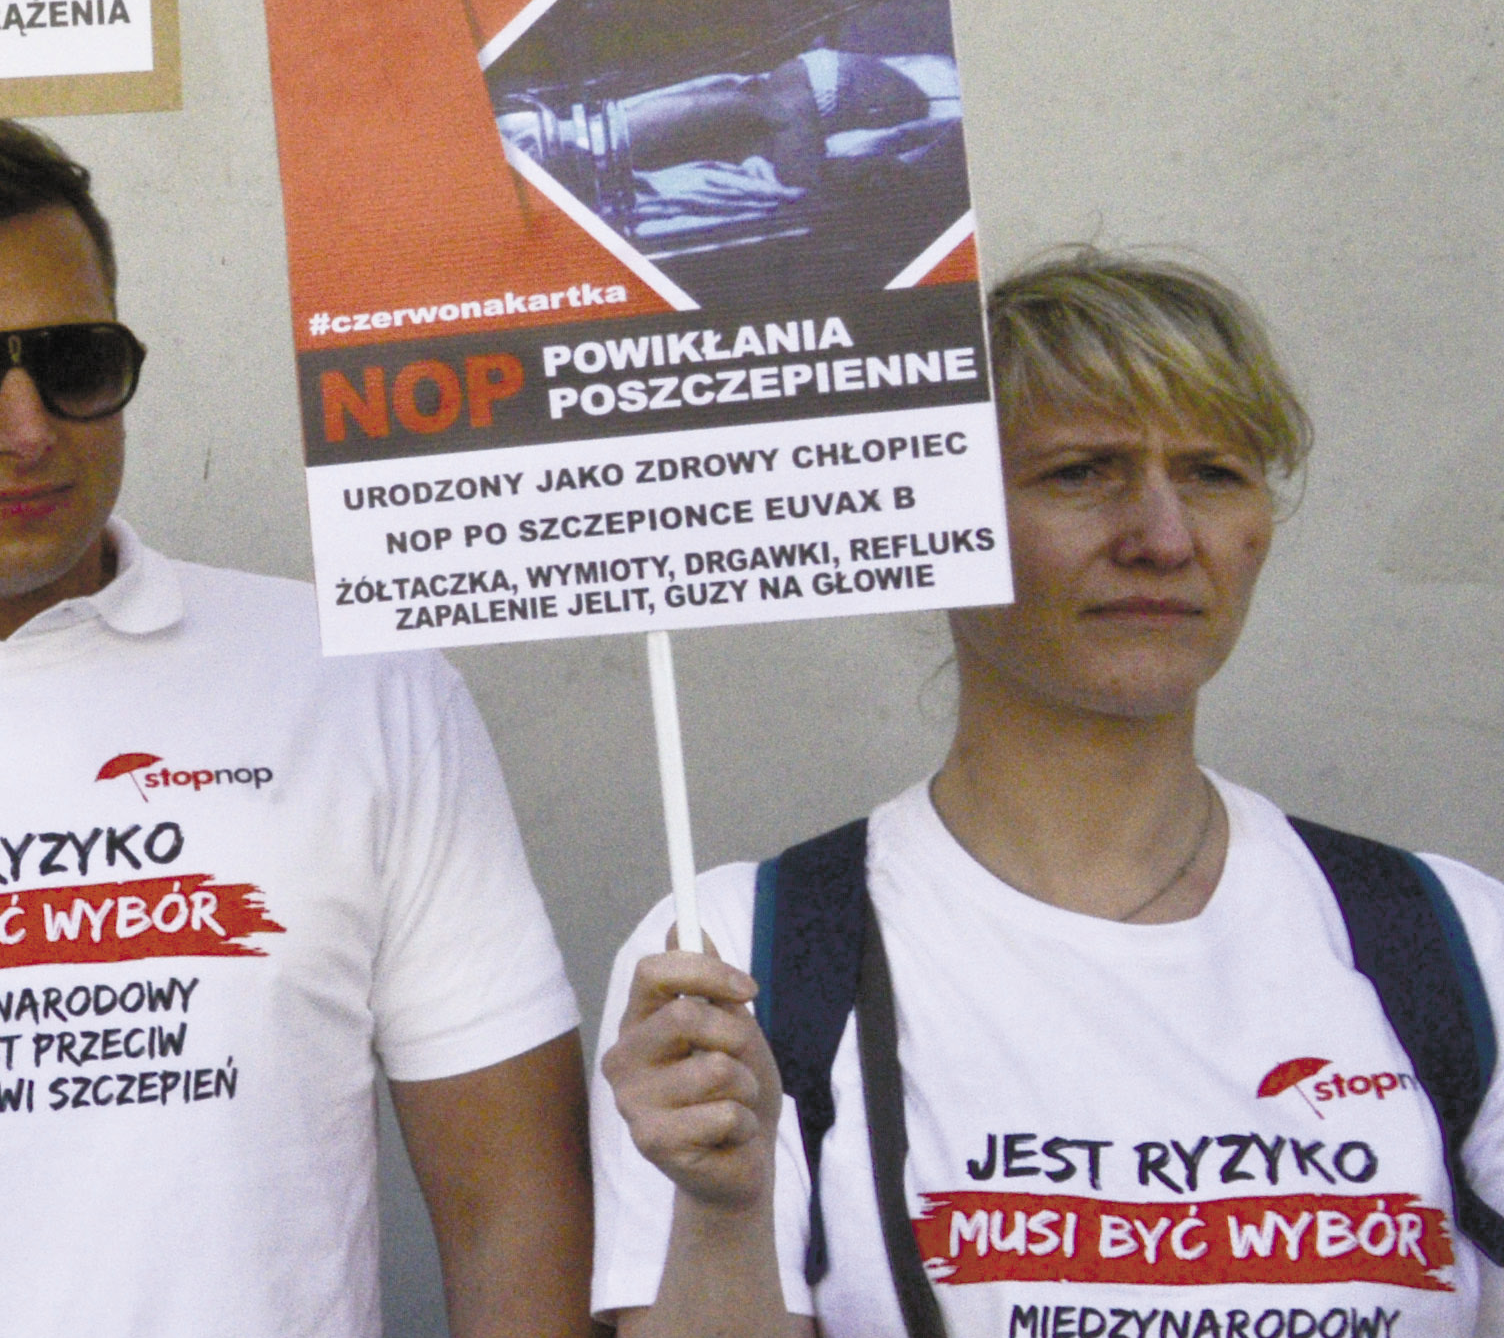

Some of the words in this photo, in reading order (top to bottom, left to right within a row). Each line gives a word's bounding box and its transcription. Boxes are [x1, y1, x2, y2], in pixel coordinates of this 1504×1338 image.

[309, 281, 629, 337] #czerwonakartka
[320, 351, 526, 444] NOP
[542, 316, 854, 378] POWIKŁANIA
[549, 347, 979, 420] POSZCZEPIENNE
[343, 472, 525, 511] URODZONY
[535, 463, 625, 496] JAKO
[635, 448, 778, 485] ZDROWY
[791, 430, 969, 470] CHŁOPIEC
[386, 527, 454, 555] NOP
[464, 520, 508, 548] PO
[518, 499, 754, 542] SZCZEPIONCE
[765, 487, 882, 522] EUVAX
[892, 485, 917, 510] B
[335, 569, 520, 607] ŻÓŁTACZKA,
[526, 555, 676, 592] WYMIOTY,
[684, 540, 841, 577] DRGAWKI,
[849, 527, 996, 563] REFLUKS
[395, 595, 559, 632] ZAPALENIE
[567, 586, 656, 617] JELIT,
[664, 579, 747, 610] GUZY
[759, 575, 802, 601] NA
[811, 563, 936, 596] GŁOWIE
[145, 765, 273, 791] stopnop
[43, 881, 227, 943] WYBÓR
[34, 1022, 188, 1066] PRZECIW
[49, 1056, 239, 1111] SZCZEPIEŃ
[966, 1133, 1114, 1190] JEST
[1133, 1133, 1378, 1194] RYZYKO
[949, 1209, 1077, 1259] MUSI
[1099, 1205, 1207, 1265] BYĆ
[1227, 1199, 1427, 1265] WYBÓR
